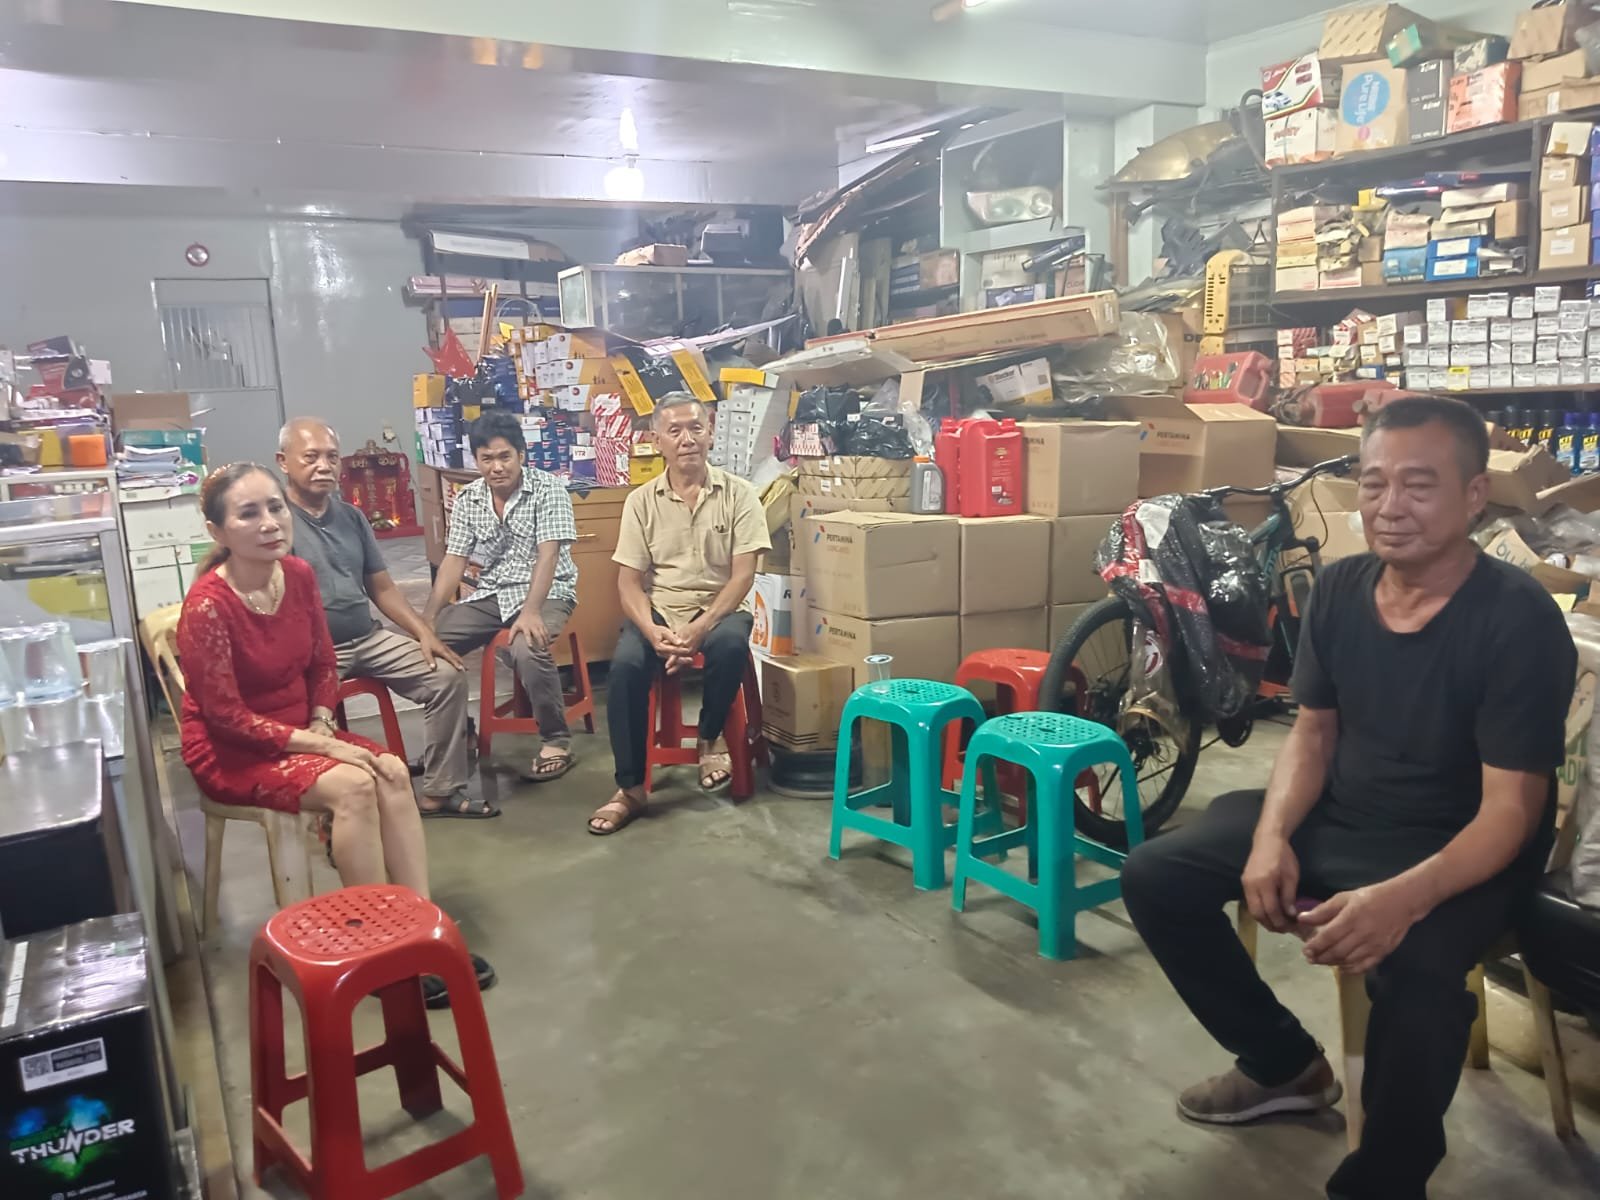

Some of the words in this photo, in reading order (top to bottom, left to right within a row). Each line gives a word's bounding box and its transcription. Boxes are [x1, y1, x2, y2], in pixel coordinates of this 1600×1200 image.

[826, 533, 854, 544] PERTAMINA
[829, 627, 857, 640] PERTAMINA
[10, 1118, 136, 1165] THUNDER
